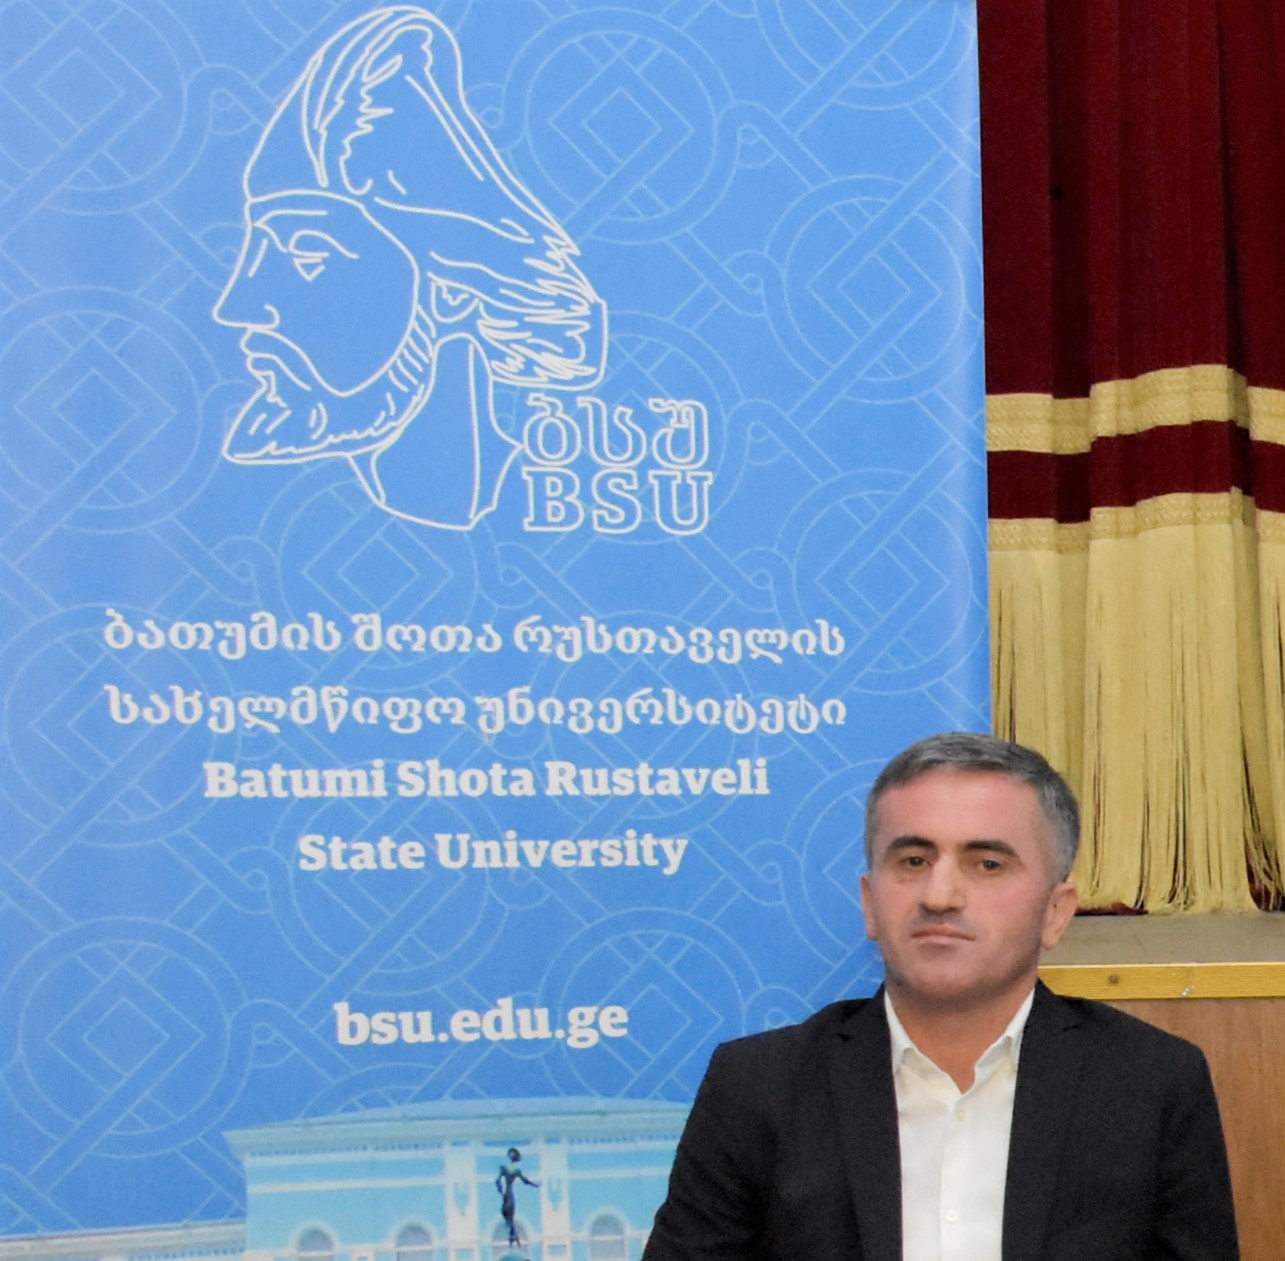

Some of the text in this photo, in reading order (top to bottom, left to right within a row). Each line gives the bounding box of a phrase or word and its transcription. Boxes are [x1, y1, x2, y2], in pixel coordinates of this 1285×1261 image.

[521, 466, 714, 536] BSU
[103, 608, 846, 665] ბათუმის შოთა რუსთაველის
[103, 684, 848, 735] სახელმწიფო უნივერსიტეტი
[202, 756, 772, 799] Batumi Shota Rustaveli
[298, 828, 689, 876] State University
[333, 997, 629, 1048] bsu.edu.ge
